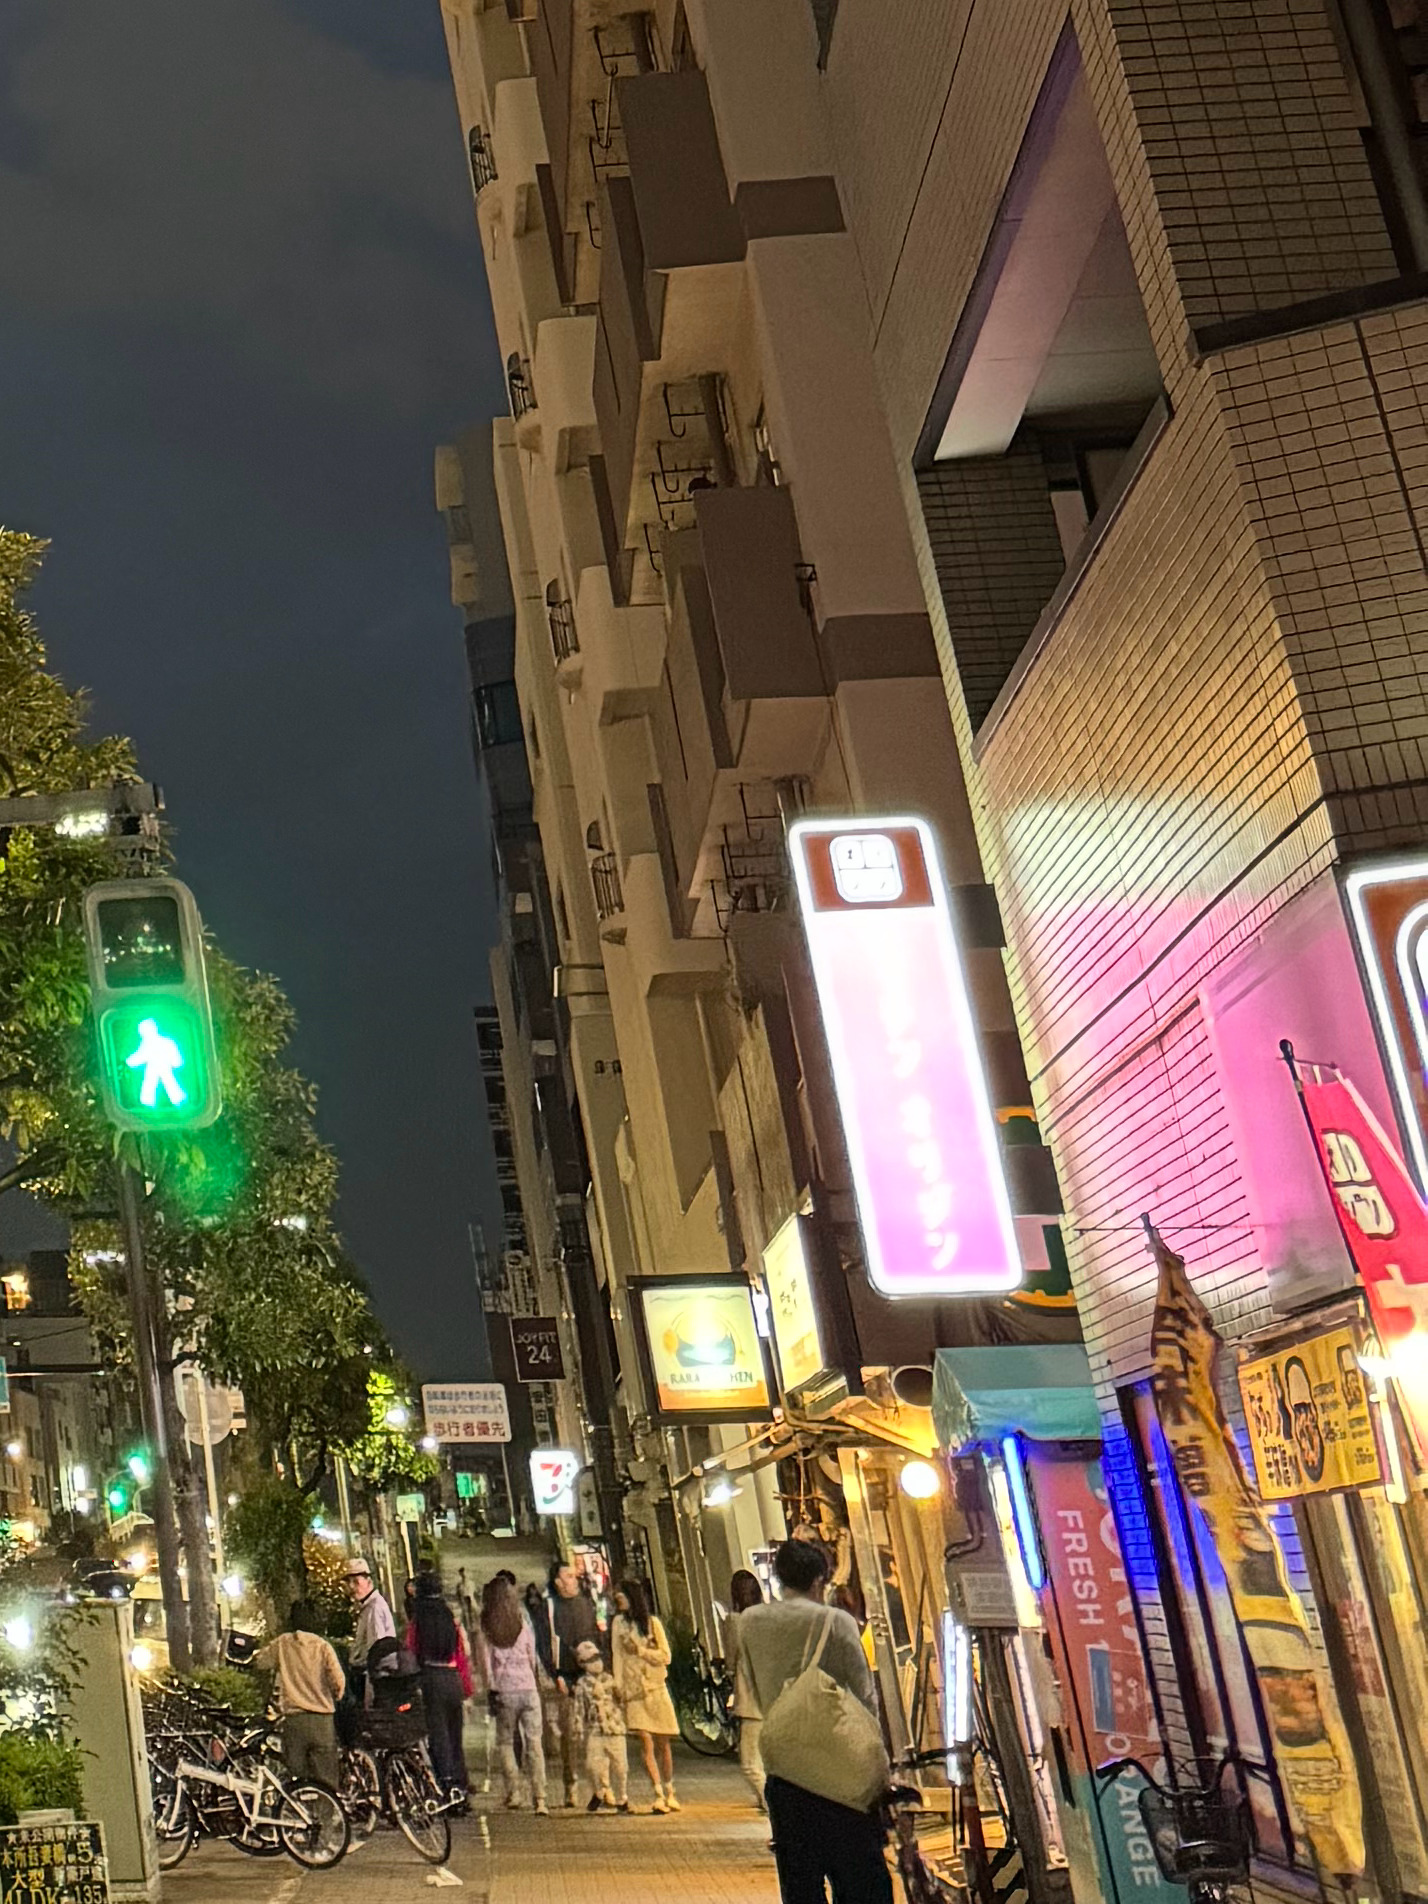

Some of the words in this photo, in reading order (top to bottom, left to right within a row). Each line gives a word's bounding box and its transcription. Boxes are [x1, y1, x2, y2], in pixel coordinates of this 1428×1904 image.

[526, 1345, 552, 1365] 24
[433, 1421, 506, 1438] 歩行者優先
[1057, 1510, 1104, 1626] FRESH
[11, 1868, 45, 1889] 大型
